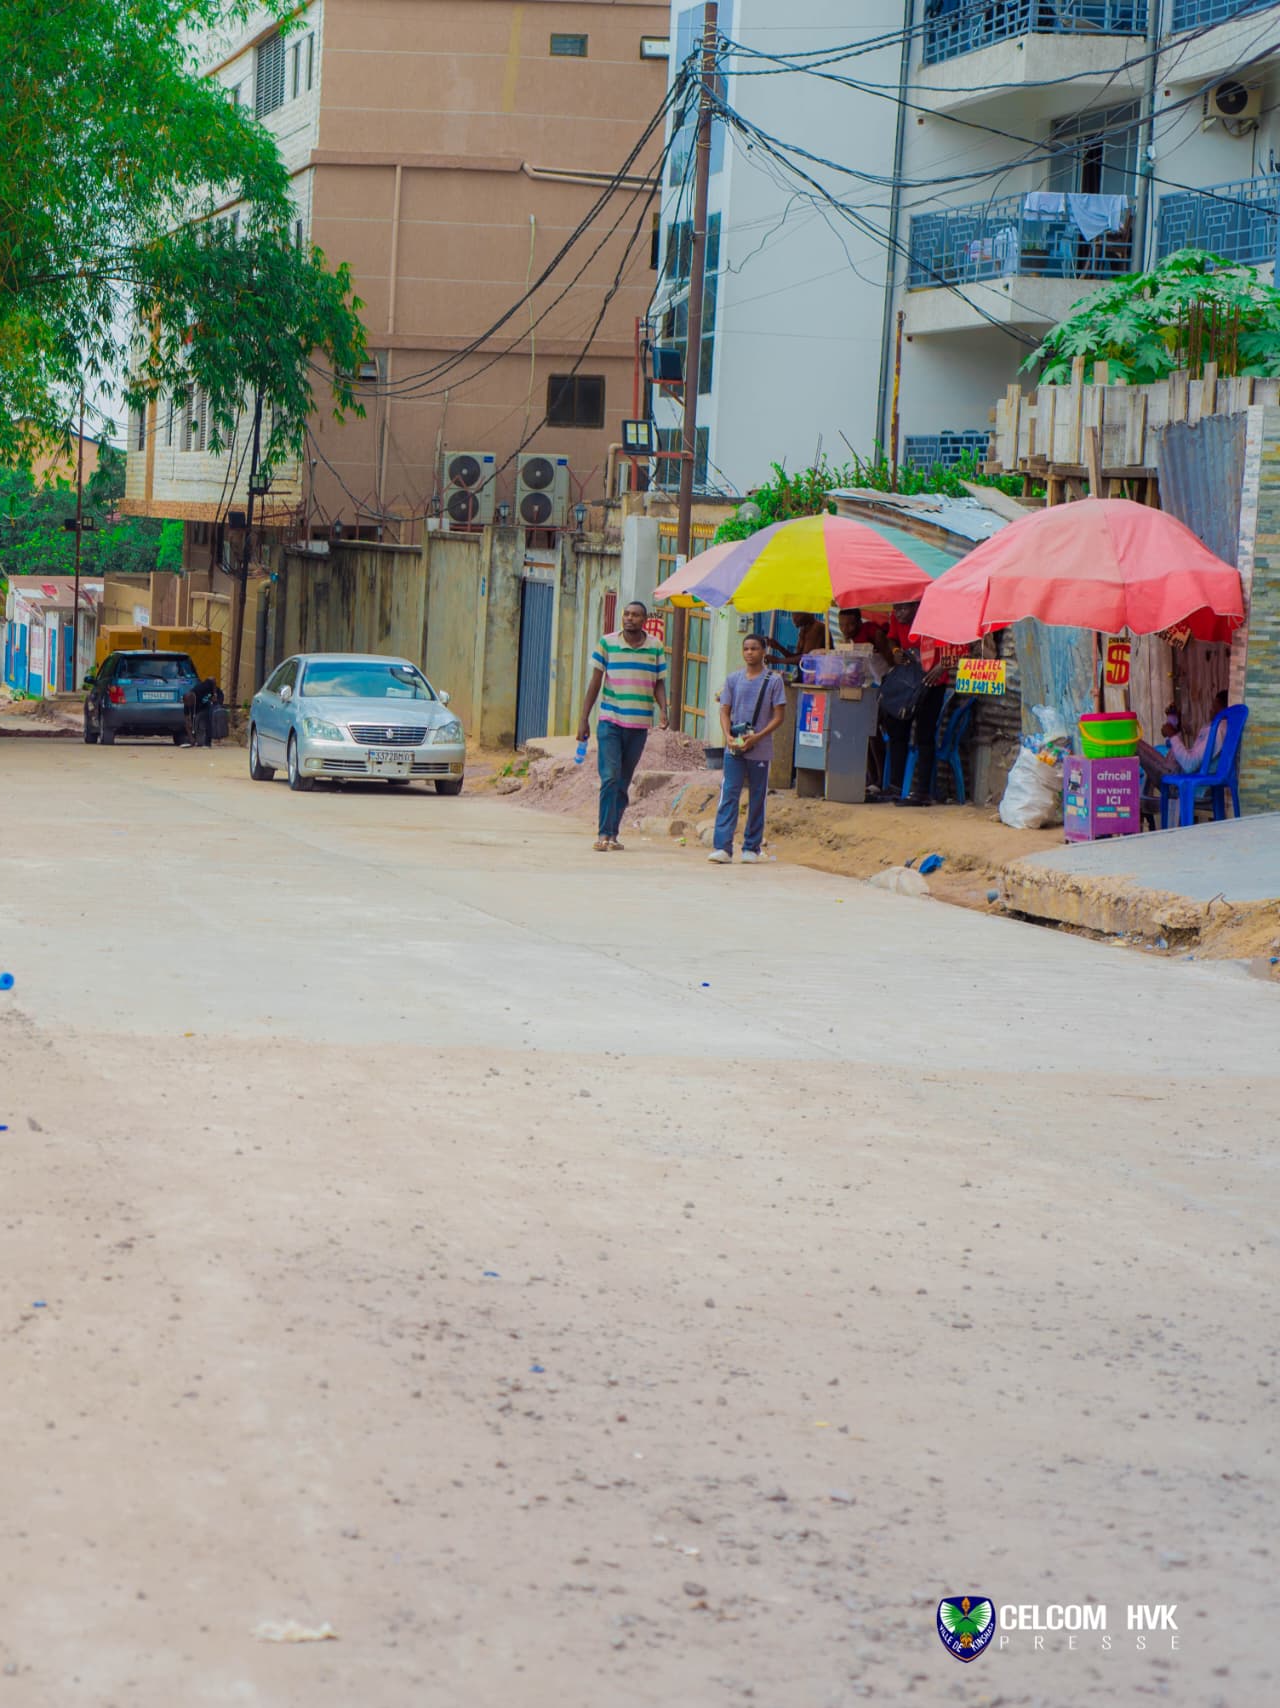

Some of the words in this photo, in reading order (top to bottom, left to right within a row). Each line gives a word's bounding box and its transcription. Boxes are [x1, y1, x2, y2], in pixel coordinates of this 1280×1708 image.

[964, 659, 1001, 670] AIRTEL
[970, 671, 998, 680] MONEY
[1097, 770, 1131, 781] africell
[1106, 796, 1121, 805] ICI
